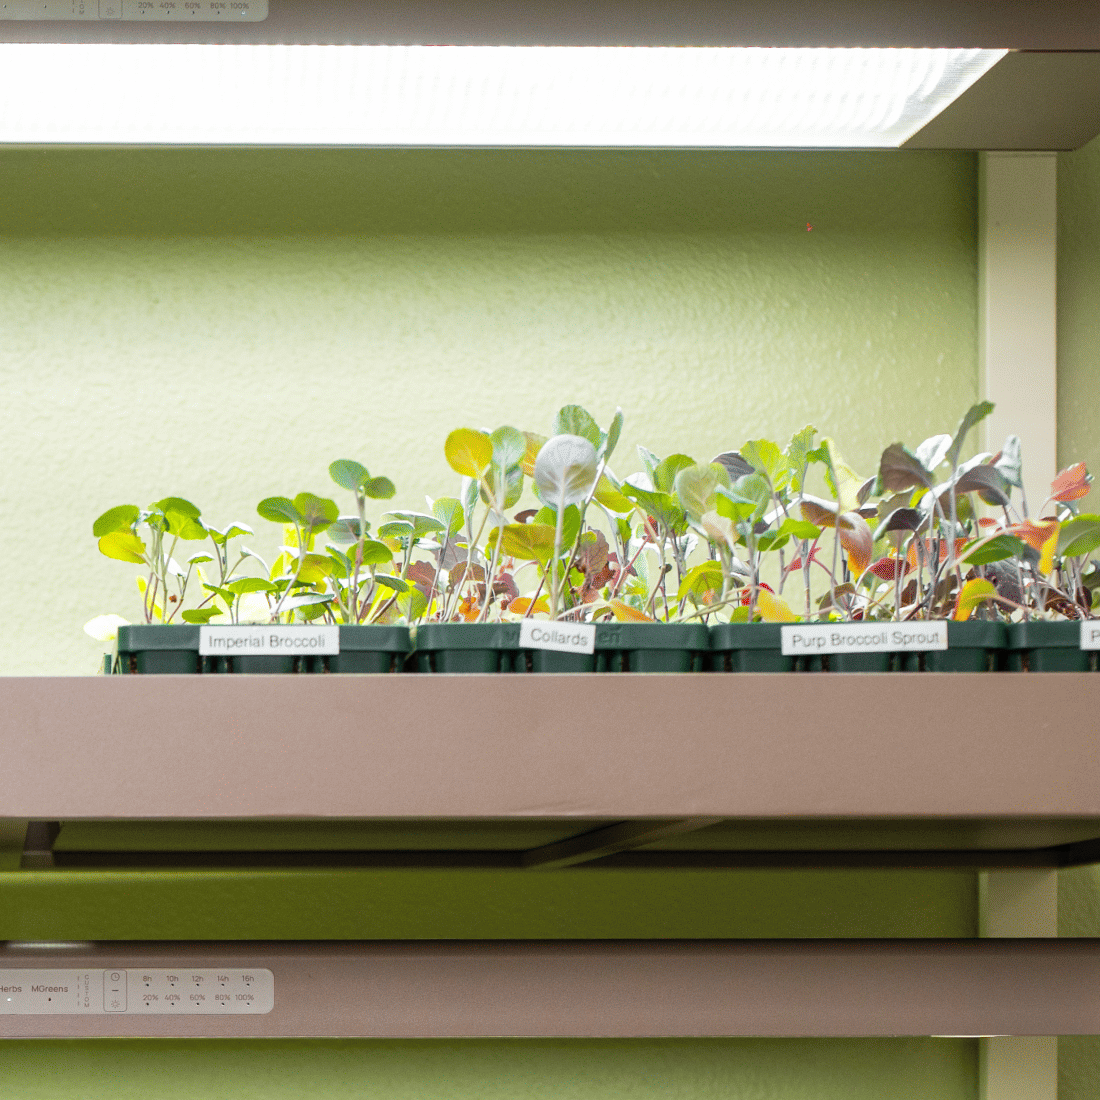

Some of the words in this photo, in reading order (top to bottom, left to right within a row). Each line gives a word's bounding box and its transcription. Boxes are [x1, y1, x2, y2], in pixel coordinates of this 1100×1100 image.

[208, 634, 265, 650] Imperial
[269, 634, 325, 648] Broccoli
[530, 628, 588, 646] Collards
[792, 634, 826, 649] Purp
[830, 632, 888, 647] Broccoli
[892, 631, 940, 646] Sprout
[31, 985, 69, 993] MGreens
